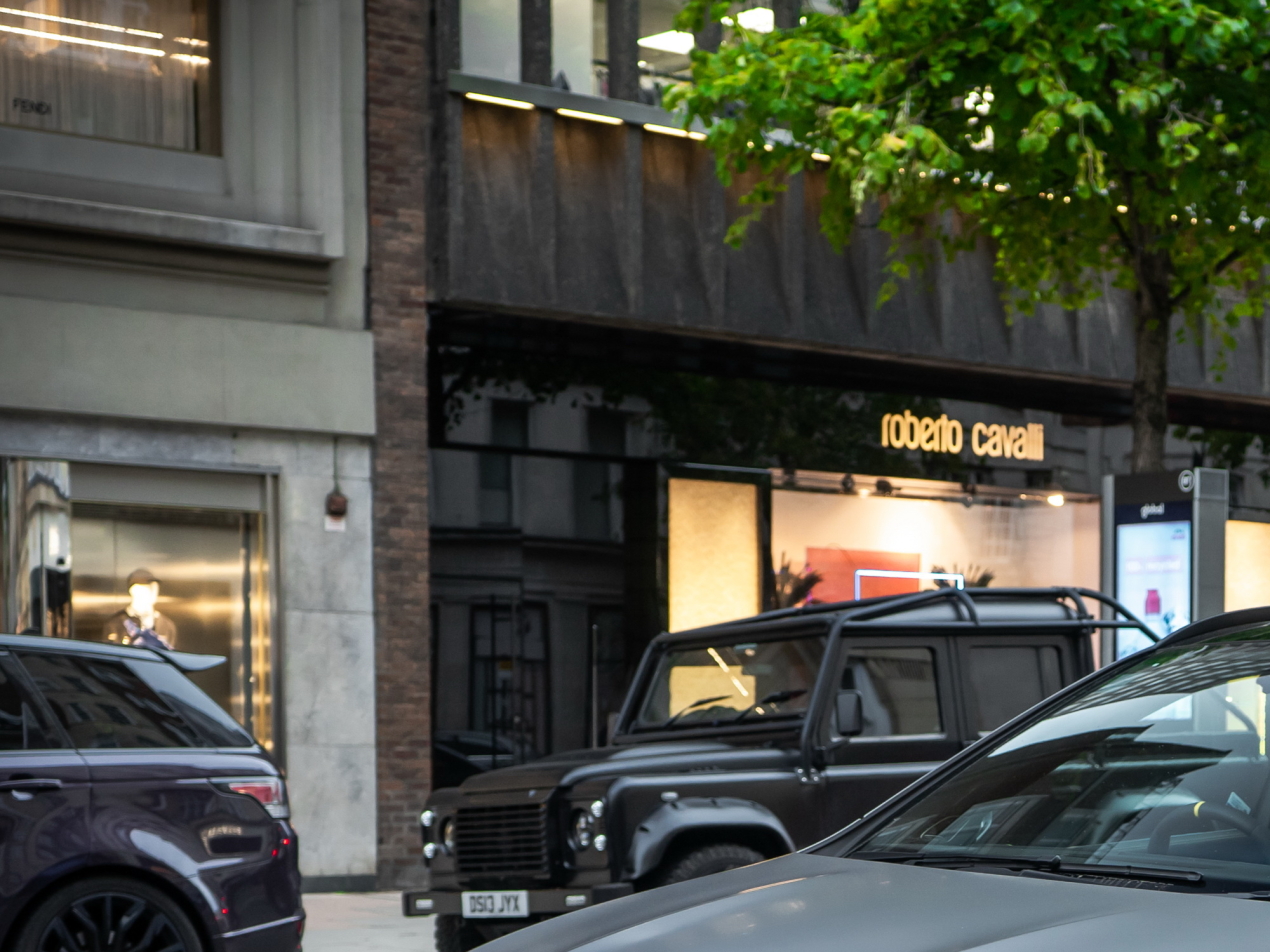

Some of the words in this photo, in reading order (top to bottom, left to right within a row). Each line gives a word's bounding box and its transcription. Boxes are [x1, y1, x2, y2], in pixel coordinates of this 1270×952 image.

[881, 409, 963, 454] roberto
[971, 421, 1044, 461] cavalli
[499, 894, 520, 912] JYX
